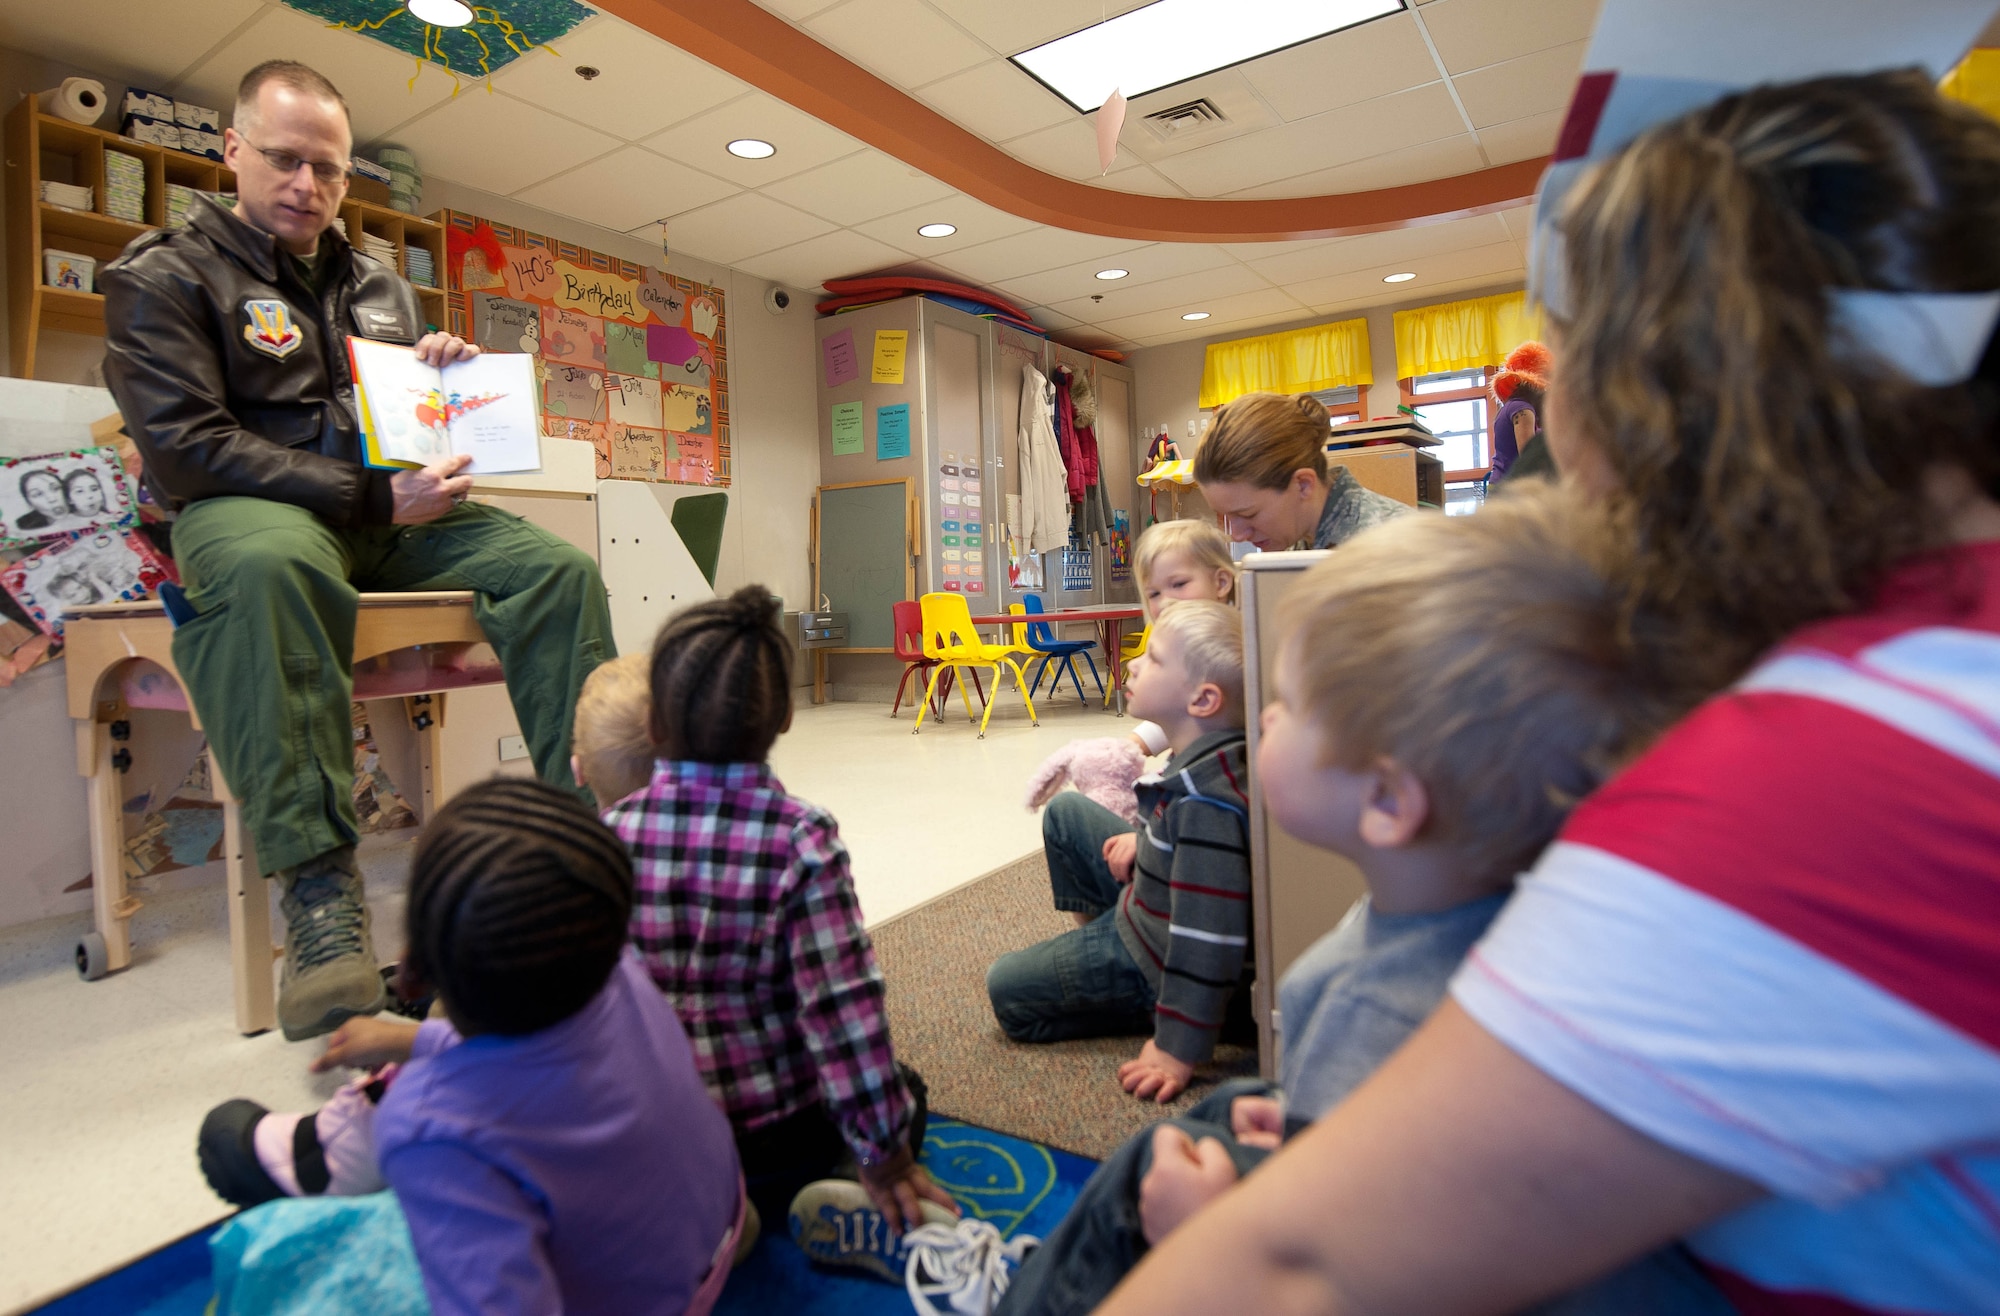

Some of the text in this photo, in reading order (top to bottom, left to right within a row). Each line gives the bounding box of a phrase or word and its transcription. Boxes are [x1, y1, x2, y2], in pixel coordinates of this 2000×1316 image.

[512, 254, 682, 316] 140's Birthday Calendar
[486, 297, 527, 318] January
